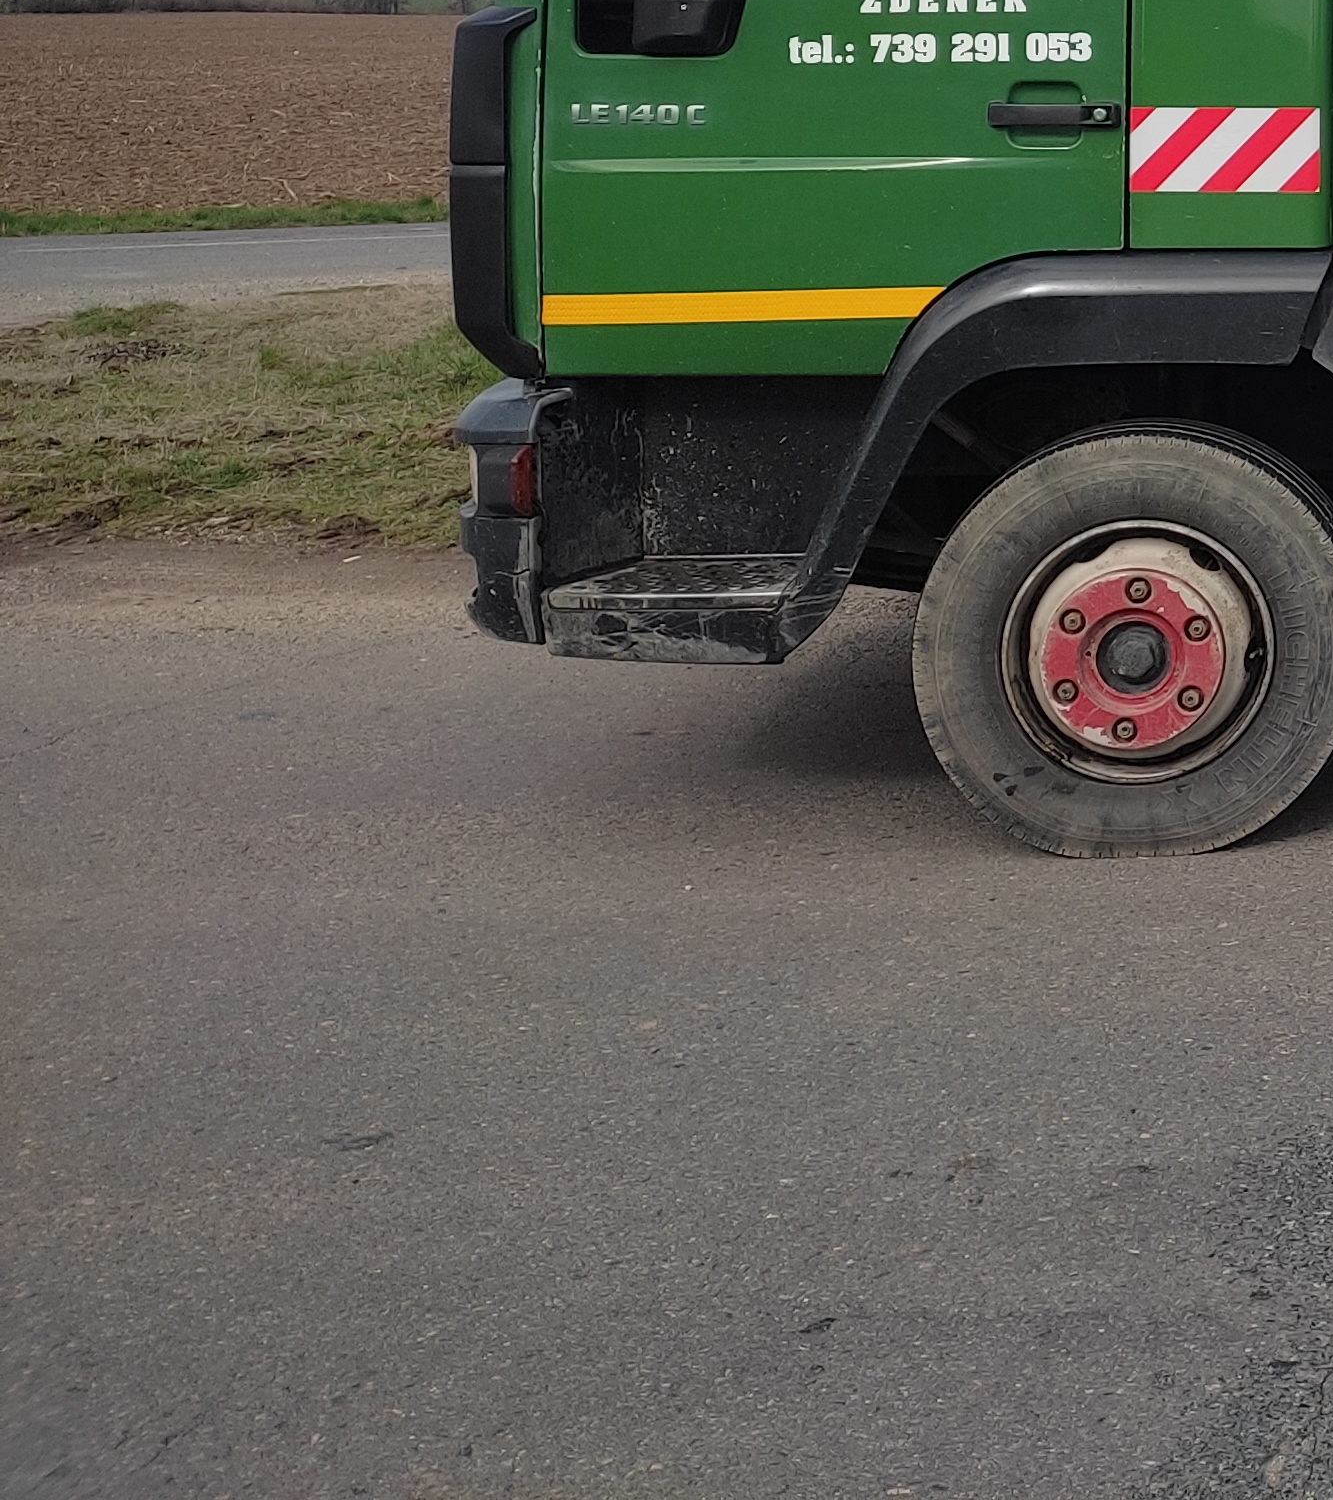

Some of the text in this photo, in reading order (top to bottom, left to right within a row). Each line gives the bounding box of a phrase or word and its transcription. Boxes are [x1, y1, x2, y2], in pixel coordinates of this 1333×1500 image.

[788, 32, 1093, 64] tel.: 739 291 053
[570, 103, 706, 125] LE 140 C
